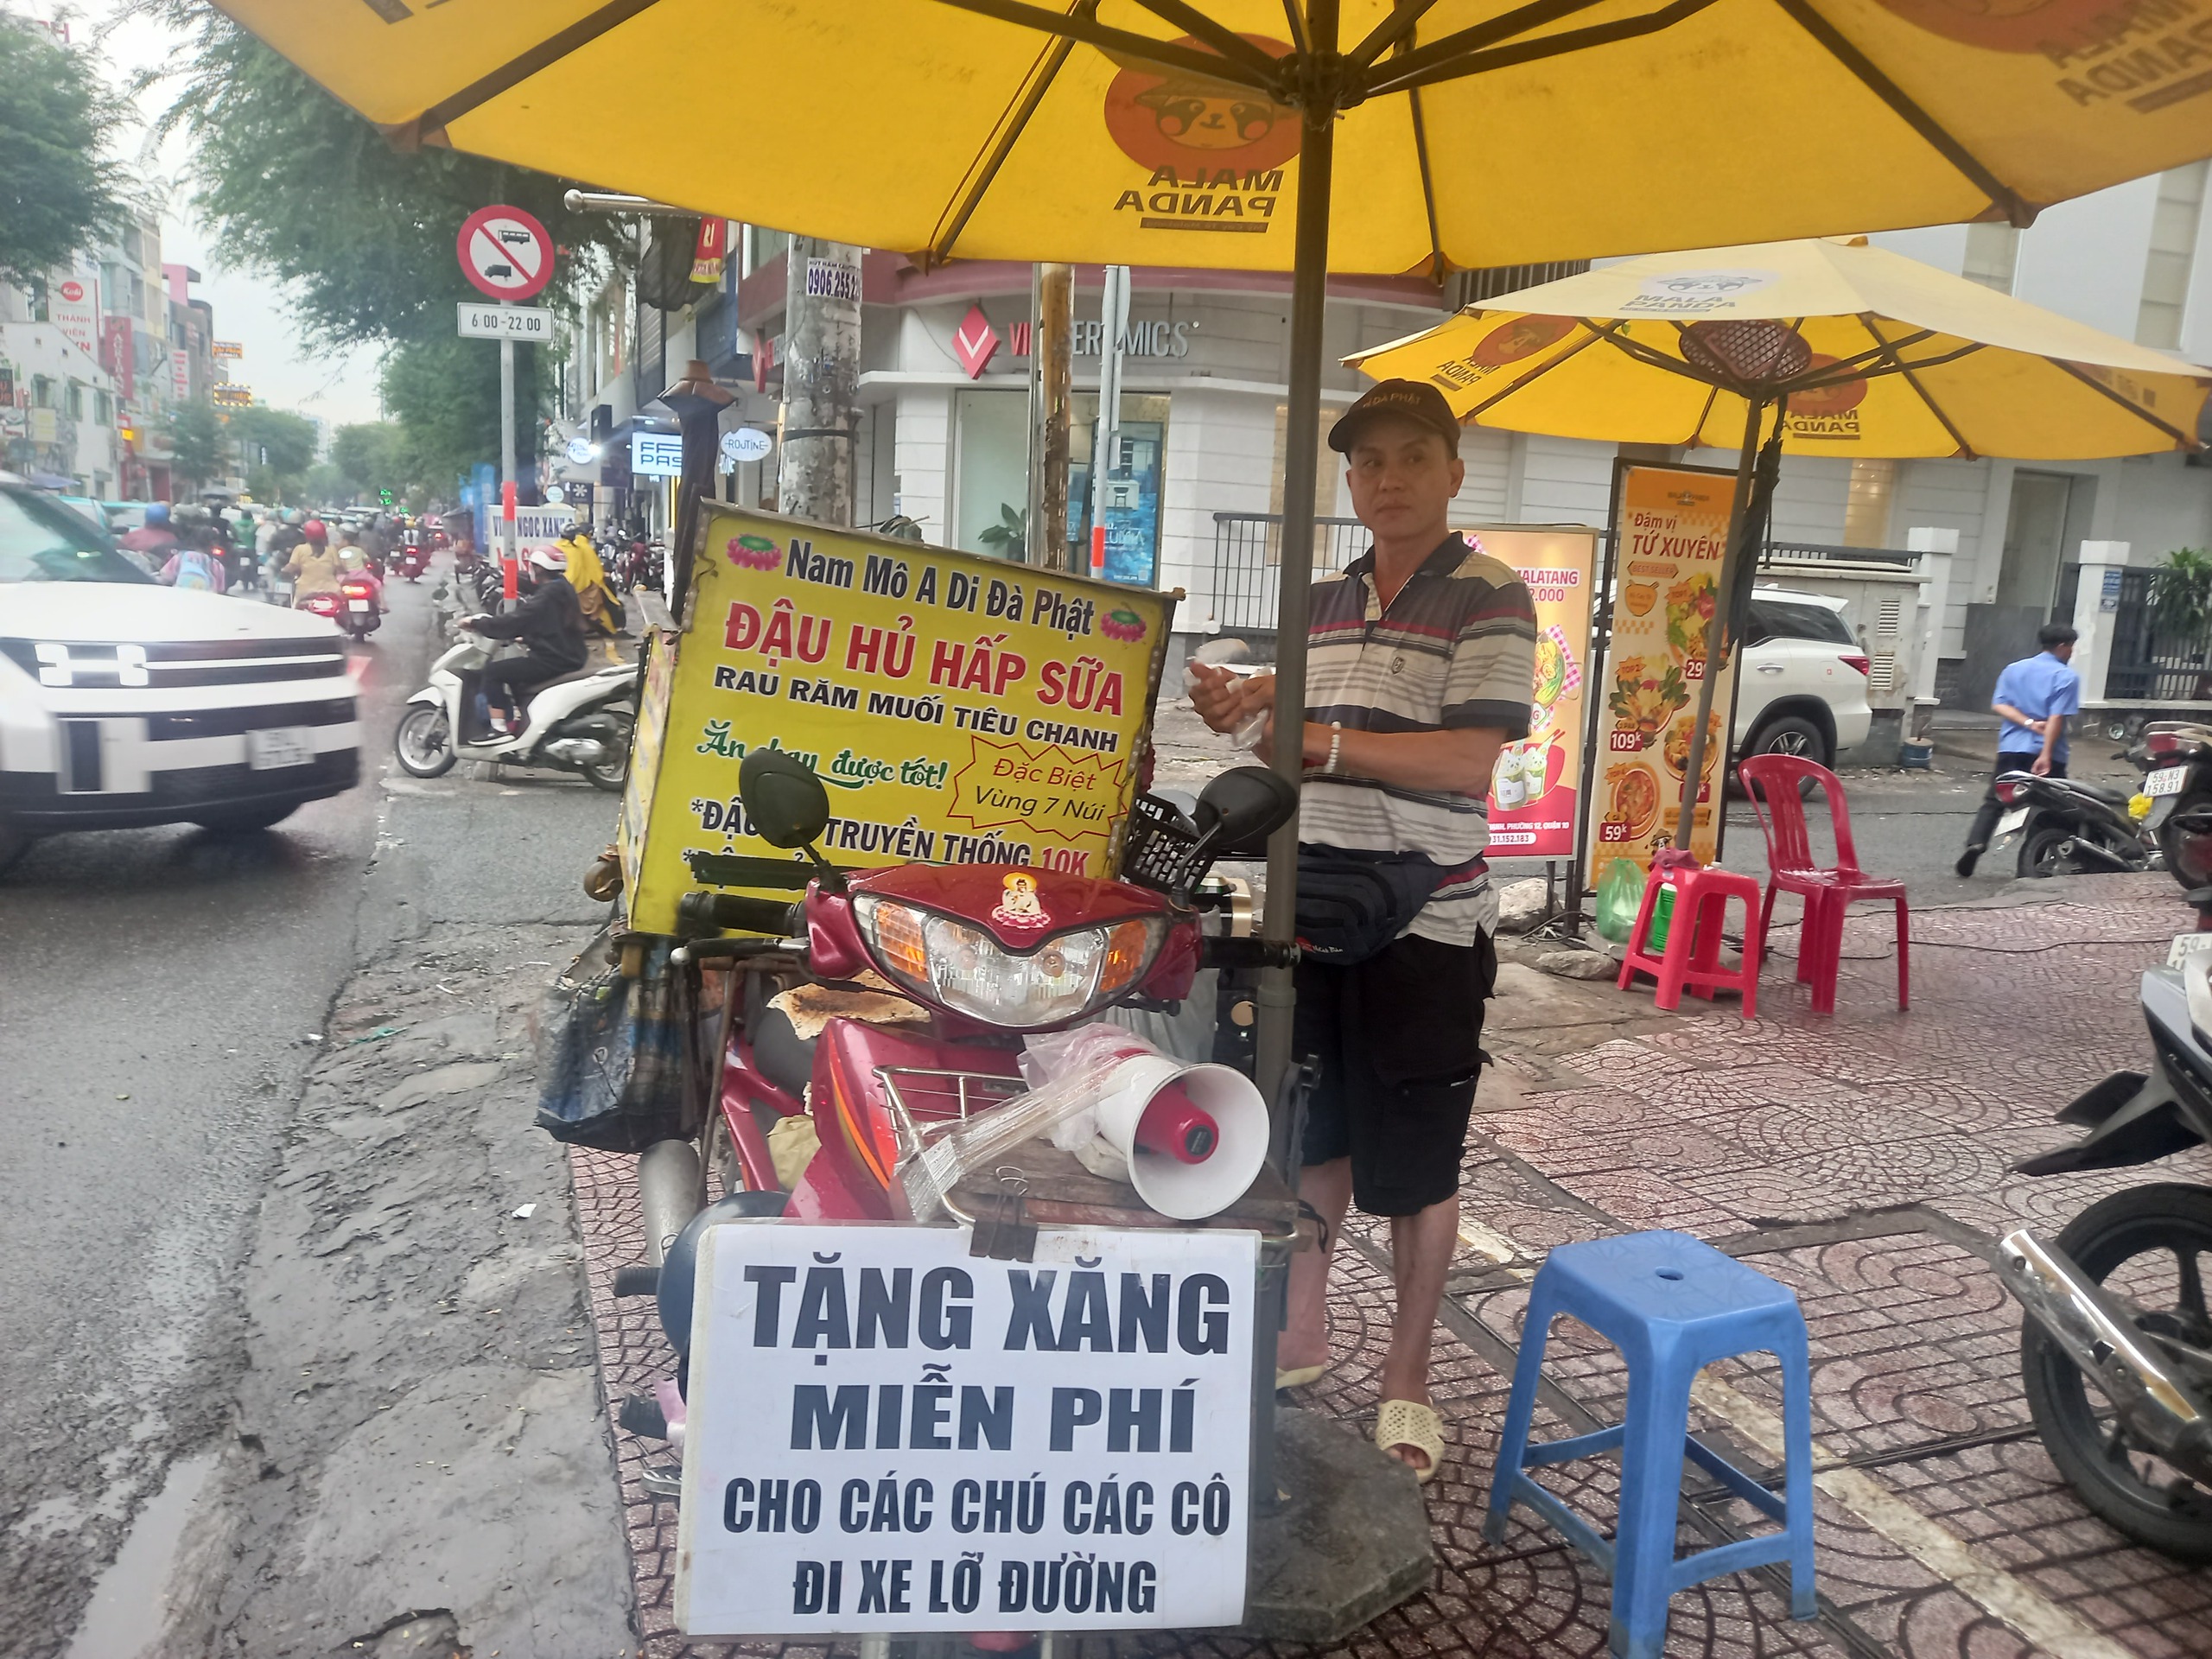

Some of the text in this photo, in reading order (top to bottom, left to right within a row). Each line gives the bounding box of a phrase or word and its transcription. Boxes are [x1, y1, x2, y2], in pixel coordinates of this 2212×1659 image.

[1632, 530, 1720, 561] TỨ XUYÊN
[1634, 512, 1678, 533] Đậm vị
[785, 538, 1095, 641] Nam Mô A Di Đà Phật
[724, 598, 1122, 716] ĐẬU HỦ HẤP SỮA
[714, 666, 1119, 753] RAU RĂM MUỐI TIÊU CHANH
[696, 720, 746, 760] Ăn
[831, 749, 895, 785] được
[899, 757, 949, 790] tốt!
[993, 758, 1096, 792] Đặc Biệt
[976, 785, 1107, 822] Vùng 7 Núi
[824, 817, 934, 861] TRUYỀN
[943, 830, 1032, 868] THỐNG
[1041, 848, 1090, 877] 10K
[744, 1251, 1230, 1365] TẶNG XĂNG
[790, 1363, 1201, 1452] MIỄN PHÍ
[723, 1470, 1230, 1536] CHO CÁC CHÚ CÁC CÔ
[791, 1551, 1157, 1615] ĐI XE LỠ ĐƯỜNG
